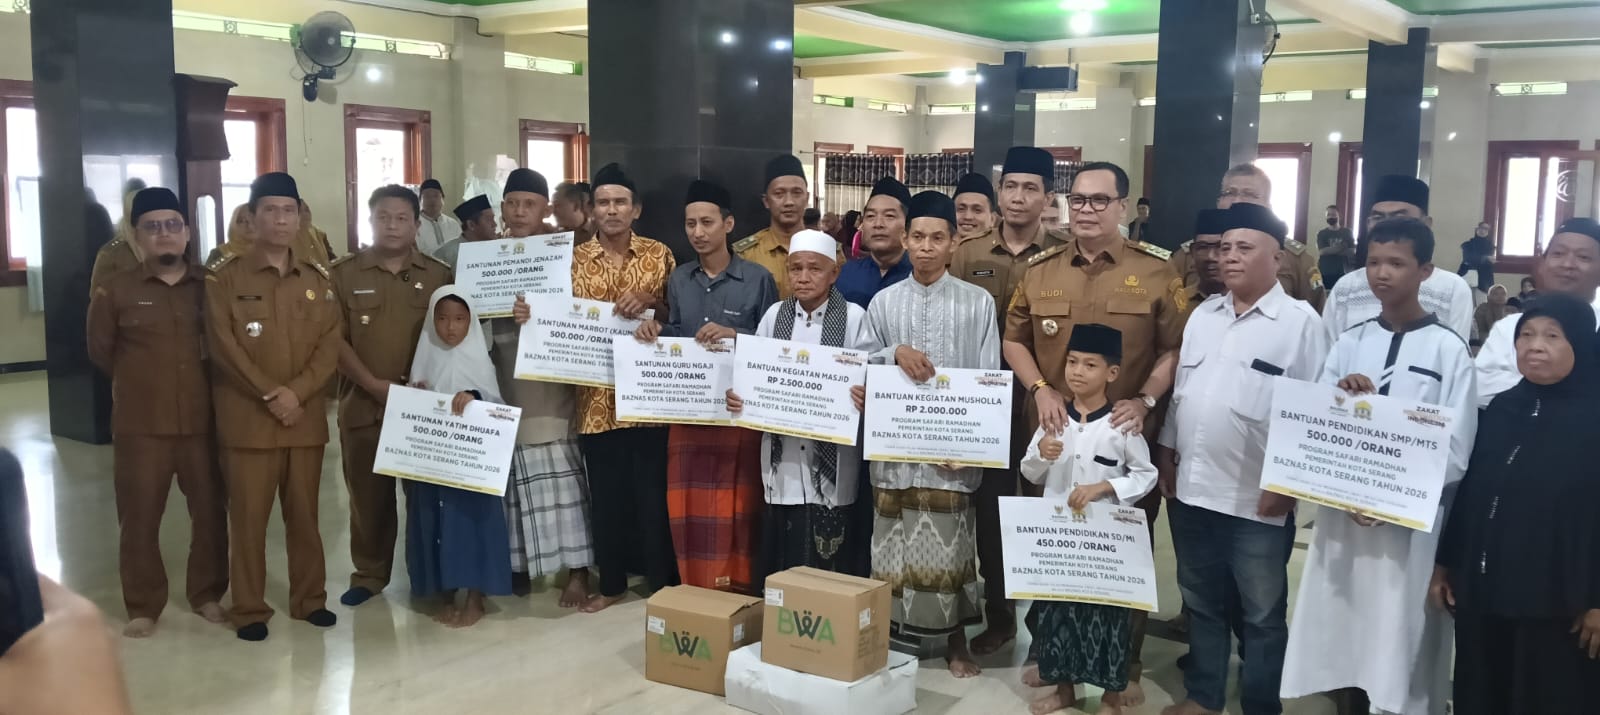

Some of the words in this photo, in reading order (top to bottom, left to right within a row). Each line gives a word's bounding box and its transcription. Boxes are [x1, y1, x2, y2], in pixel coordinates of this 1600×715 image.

[467, 260, 501, 269] SANTUNAN
[514, 266, 544, 275] /ORANG
[537, 319, 576, 328] SANTUNAN
[578, 324, 608, 334] MARBOT
[550, 331, 584, 341] 500.000
[586, 336, 613, 345] /ORAN
[524, 353, 549, 361] BAZNAS
[571, 358, 596, 366] SERANG
[641, 371, 672, 379] 500.000
[748, 362, 781, 373] BANTUAN
[782, 367, 820, 378] KEGIATAN
[822, 373, 849, 383] MASJID
[768, 376, 778, 384] RP
[780, 378, 822, 390] 2.500.000
[754, 386, 780, 395] PROGRAM
[802, 393, 834, 403] RAMADHAN
[758, 394, 790, 403] PEMERINTAH
[875, 392, 913, 400] BANTUAN
[915, 394, 956, 402] KEGIATAN
[958, 396, 1002, 405] MUSHOLLA
[762, 402, 779, 410] KOTA
[781, 404, 807, 415] SERANG
[809, 409, 831, 418] TAHUN
[833, 413, 850, 421] 2026
[906, 405, 917, 413] RP
[920, 406, 967, 415] 2.000.000
[1416, 406, 1440, 415] ZAKAT
[401, 412, 443, 426] SANTUNAN
[445, 419, 468, 430] YATIM
[469, 425, 500, 436] DHUAFA
[1281, 410, 1326, 427] BANTUAN
[1328, 419, 1389, 440] PENDIDIKAN
[1390, 433, 1437, 450] SMP/MTS
[413, 426, 447, 438] 500.000
[450, 432, 483, 445] /ORANG
[902, 432, 922, 440] KOTA
[405, 436, 432, 446] PROGRAM
[434, 441, 453, 449] SAFARI
[455, 445, 486, 455] RAMADHAN
[1306, 429, 1353, 447] 500.000
[1355, 439, 1401, 458] /ORANG
[385, 447, 412, 457] BAZNAS
[414, 452, 431, 460] KOTA
[433, 456, 459, 466] SERANG
[461, 461, 483, 470] TAHUN
[1299, 443, 1333, 457] PROGRAM
[1335, 451, 1362, 463] SAFARI
[1363, 457, 1407, 473] RAMADHAN
[1305, 454, 1347, 468] PEMERINTAH
[1348, 463, 1367, 473] KOTA
[1368, 467, 1396, 480] SERANG
[1273, 456, 1307, 470] BAZNAS
[1309, 464, 1332, 476] KOTA
[1335, 471, 1369, 485] SERANG
[1372, 479, 1402, 493] TAHUN
[1405, 487, 1427, 499] 2026
[1016, 526, 1057, 535] BANTUAN
[1059, 528, 1109, 539] PENDIDIKAN
[1111, 533, 1135, 543] SD/MI
[1036, 539, 1076, 548] 450.000
[1079, 541, 1116, 552] /ORANG
[1031, 552, 1062, 560] PROGRAM
[1088, 556, 1124, 564] RAMADHAN
[1039, 560, 1076, 568] PEMERINTAH
[1012, 567, 1042, 575] BAZNAS
[1045, 568, 1065, 576] KOTA
[1068, 570, 1097, 579] SERANG
[1100, 573, 1125, 582] TAHUN
[1127, 576, 1145, 584] 2026
